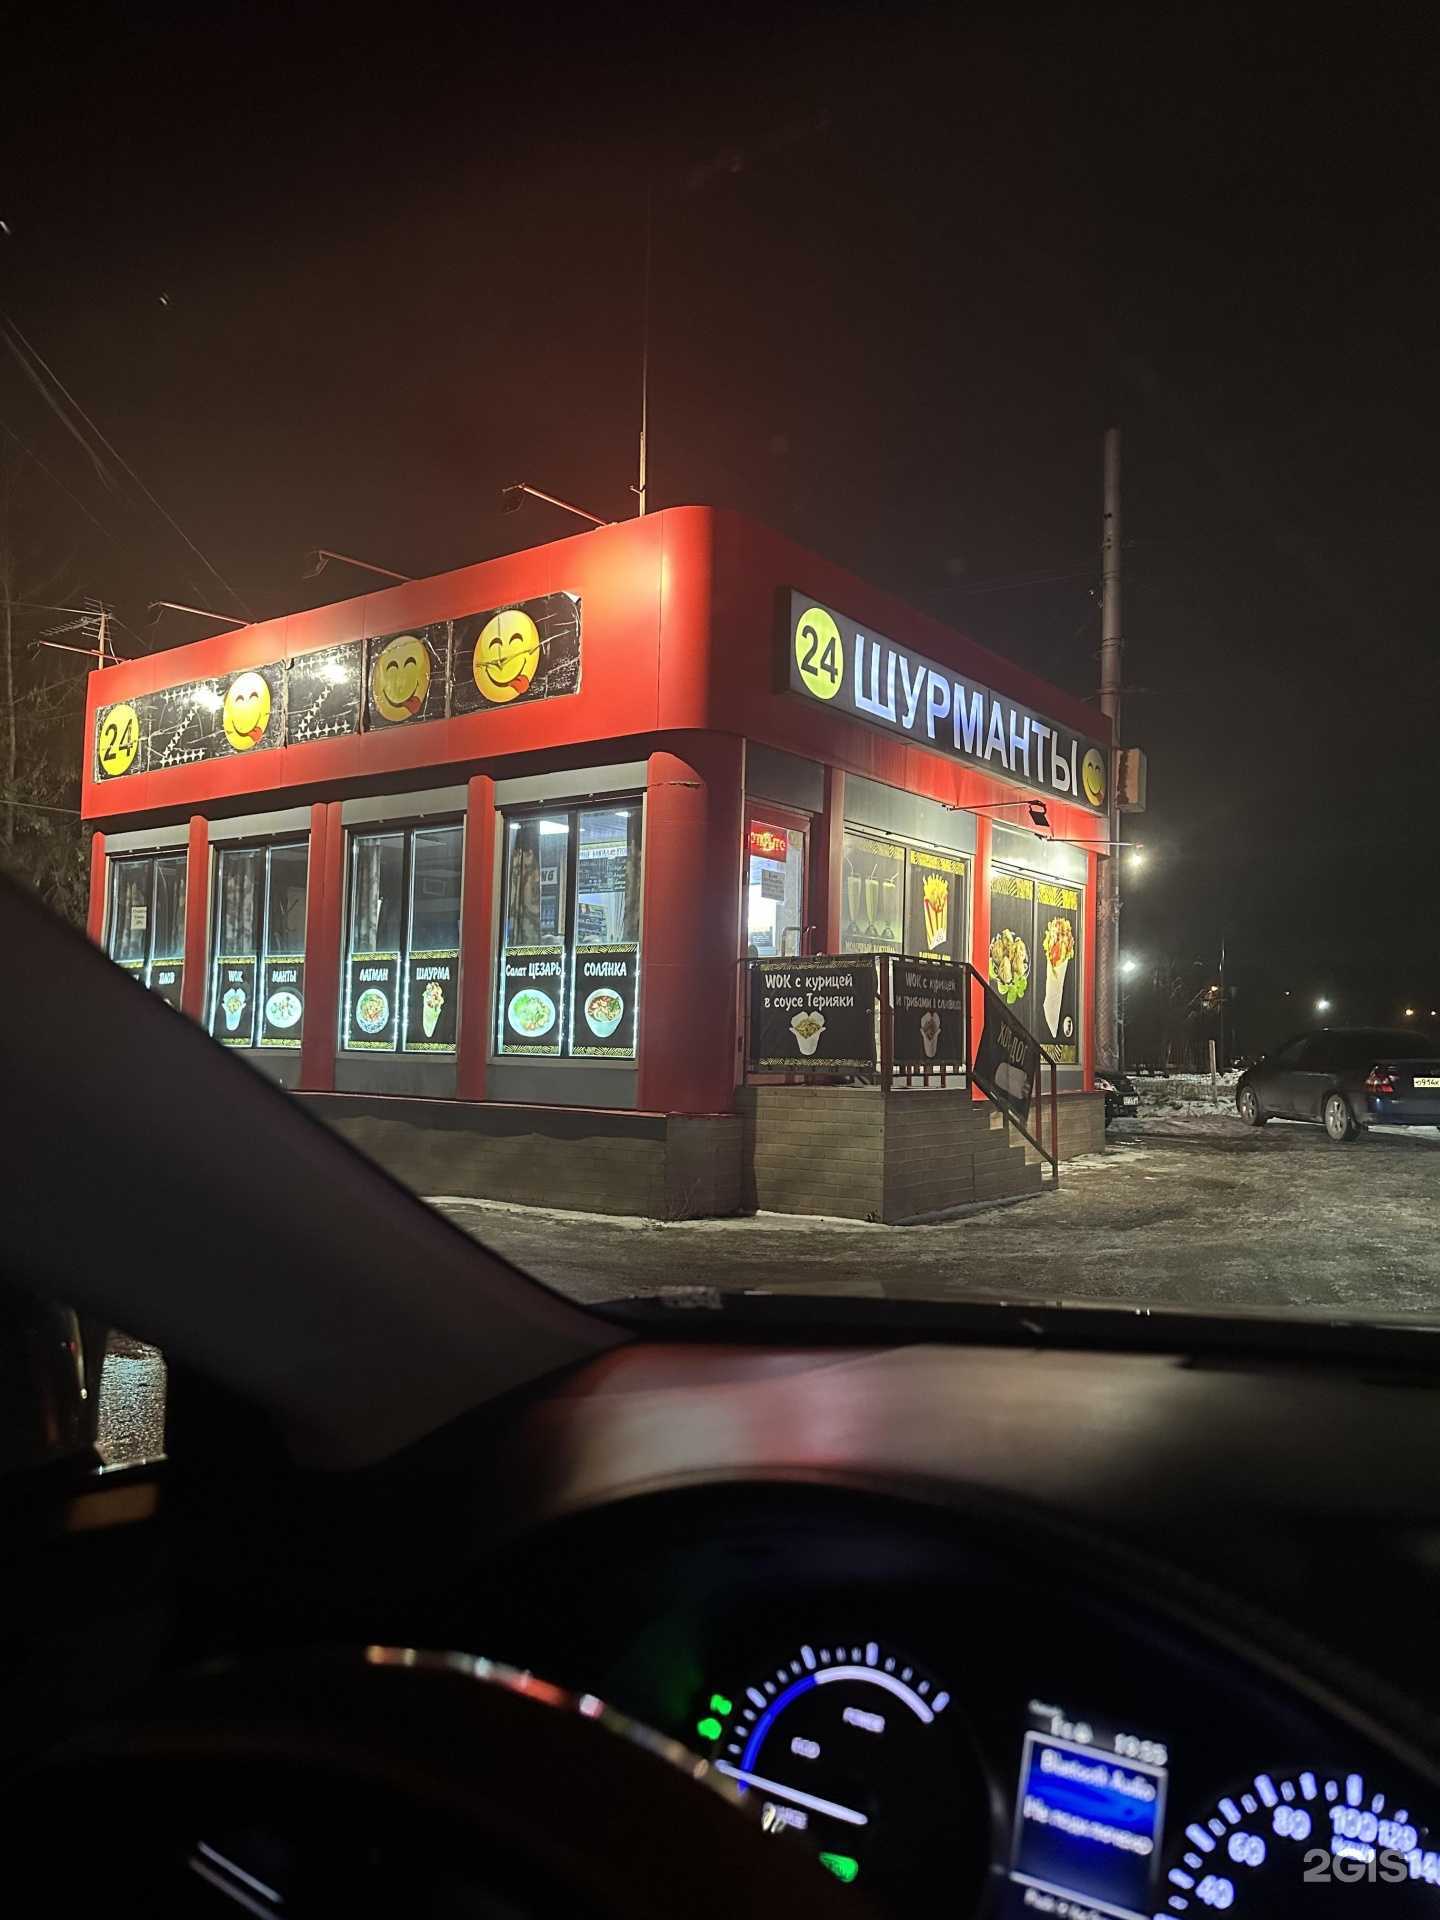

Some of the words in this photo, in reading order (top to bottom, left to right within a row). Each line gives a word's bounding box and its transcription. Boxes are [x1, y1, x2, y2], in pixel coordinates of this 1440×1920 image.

[800, 624, 840, 684] 24
[854, 632, 1079, 797] ШУРМАНТЫ
[103, 719, 134, 764] 24
[271, 969, 297, 983] МАНТЫ
[415, 966, 451, 981] ШАУРМА
[506, 964, 527, 977] Салат
[528, 962, 562, 980] ЦЕЗАРЬ
[584, 961, 627, 977] СОЛЯНКА
[765, 974, 792, 989] WOK
[795, 976, 802, 988] с
[805, 973, 853, 991] курицей
[764, 997, 771, 1008] в
[774, 996, 804, 1011] соусе
[806, 993, 854, 1011] Терияки
[1111, 1769, 1157, 1803] Audio
[1329, 1803, 1379, 1844] 100
